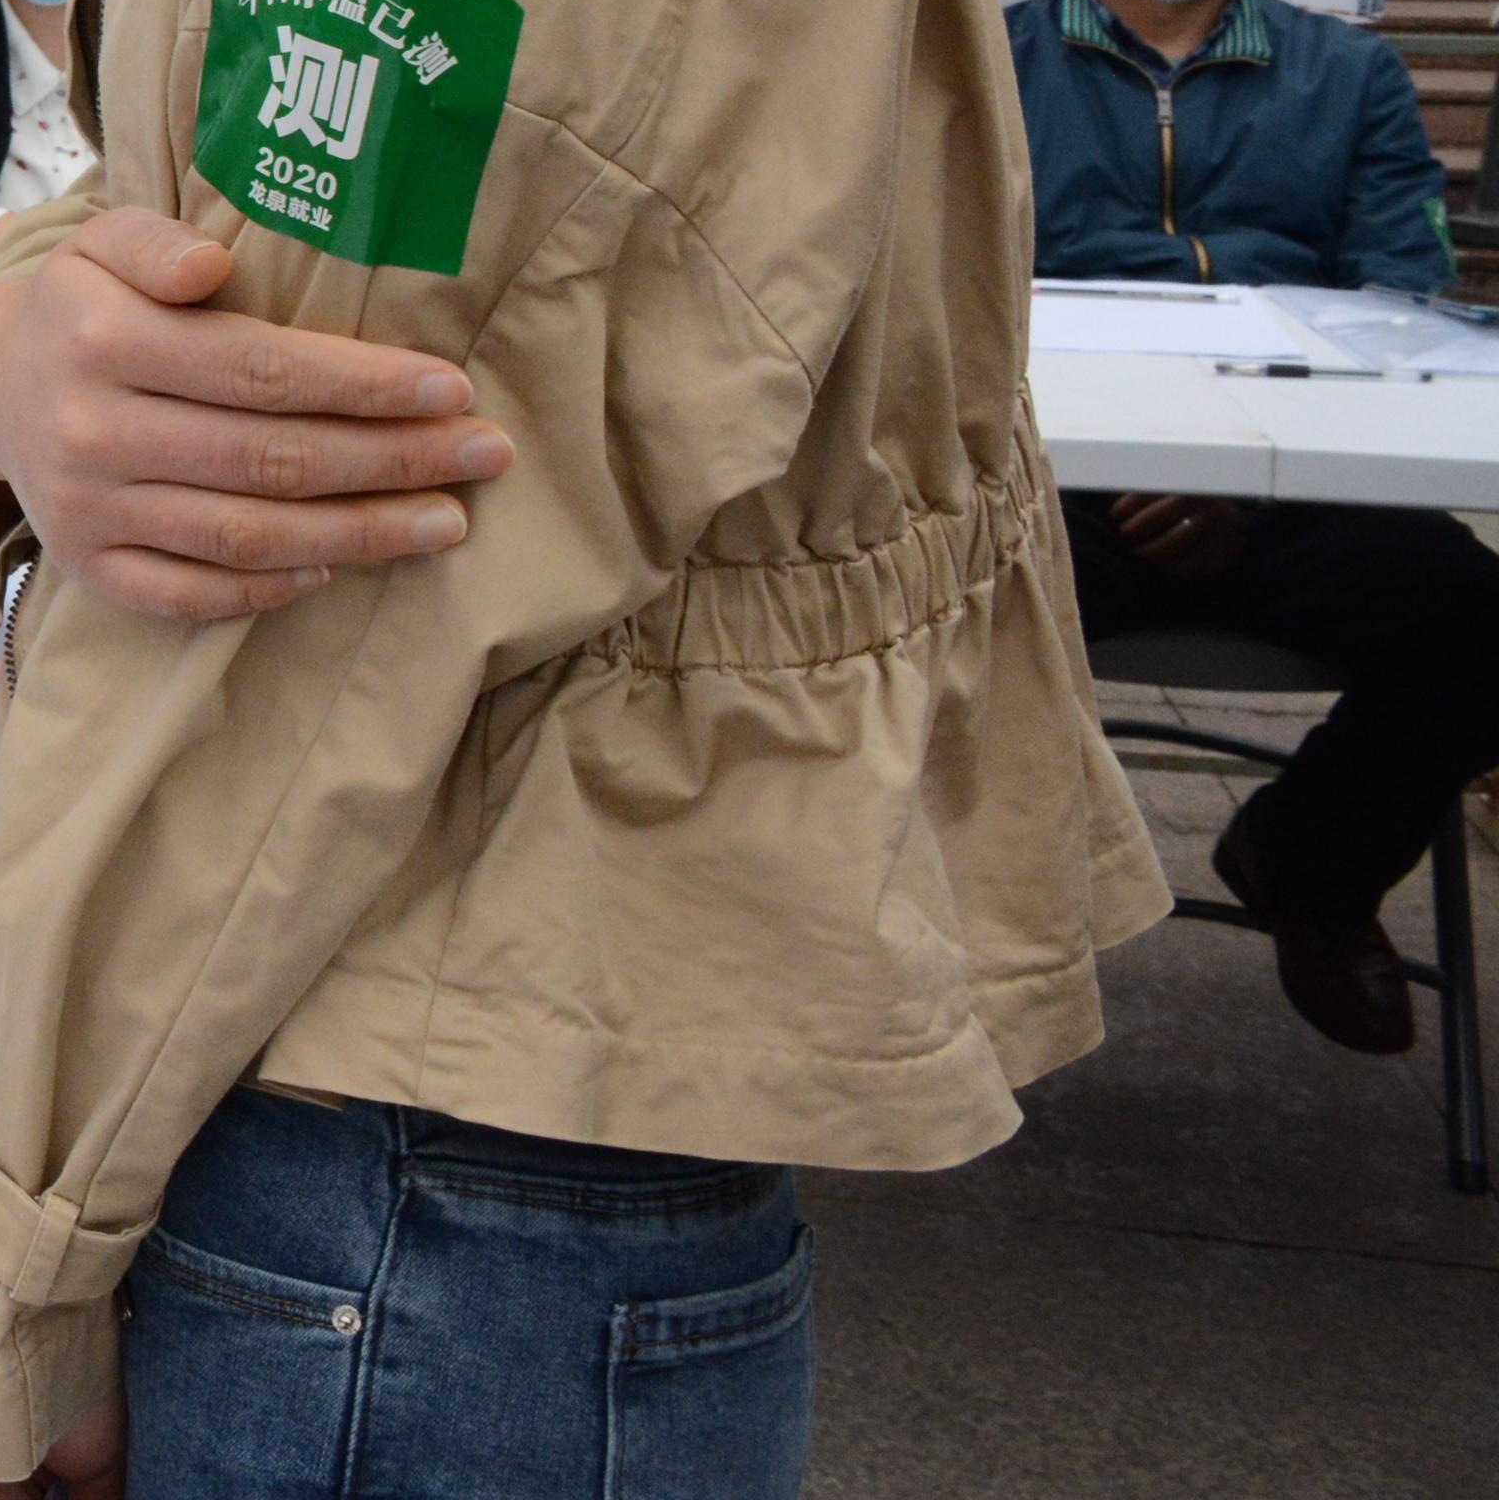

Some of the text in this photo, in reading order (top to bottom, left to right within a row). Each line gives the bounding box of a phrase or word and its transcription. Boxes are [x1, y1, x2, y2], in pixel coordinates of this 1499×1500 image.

[258, 25, 380, 160] 测
[254, 146, 338, 201] 2020
[247, 179, 334, 232] 龙泉就业
